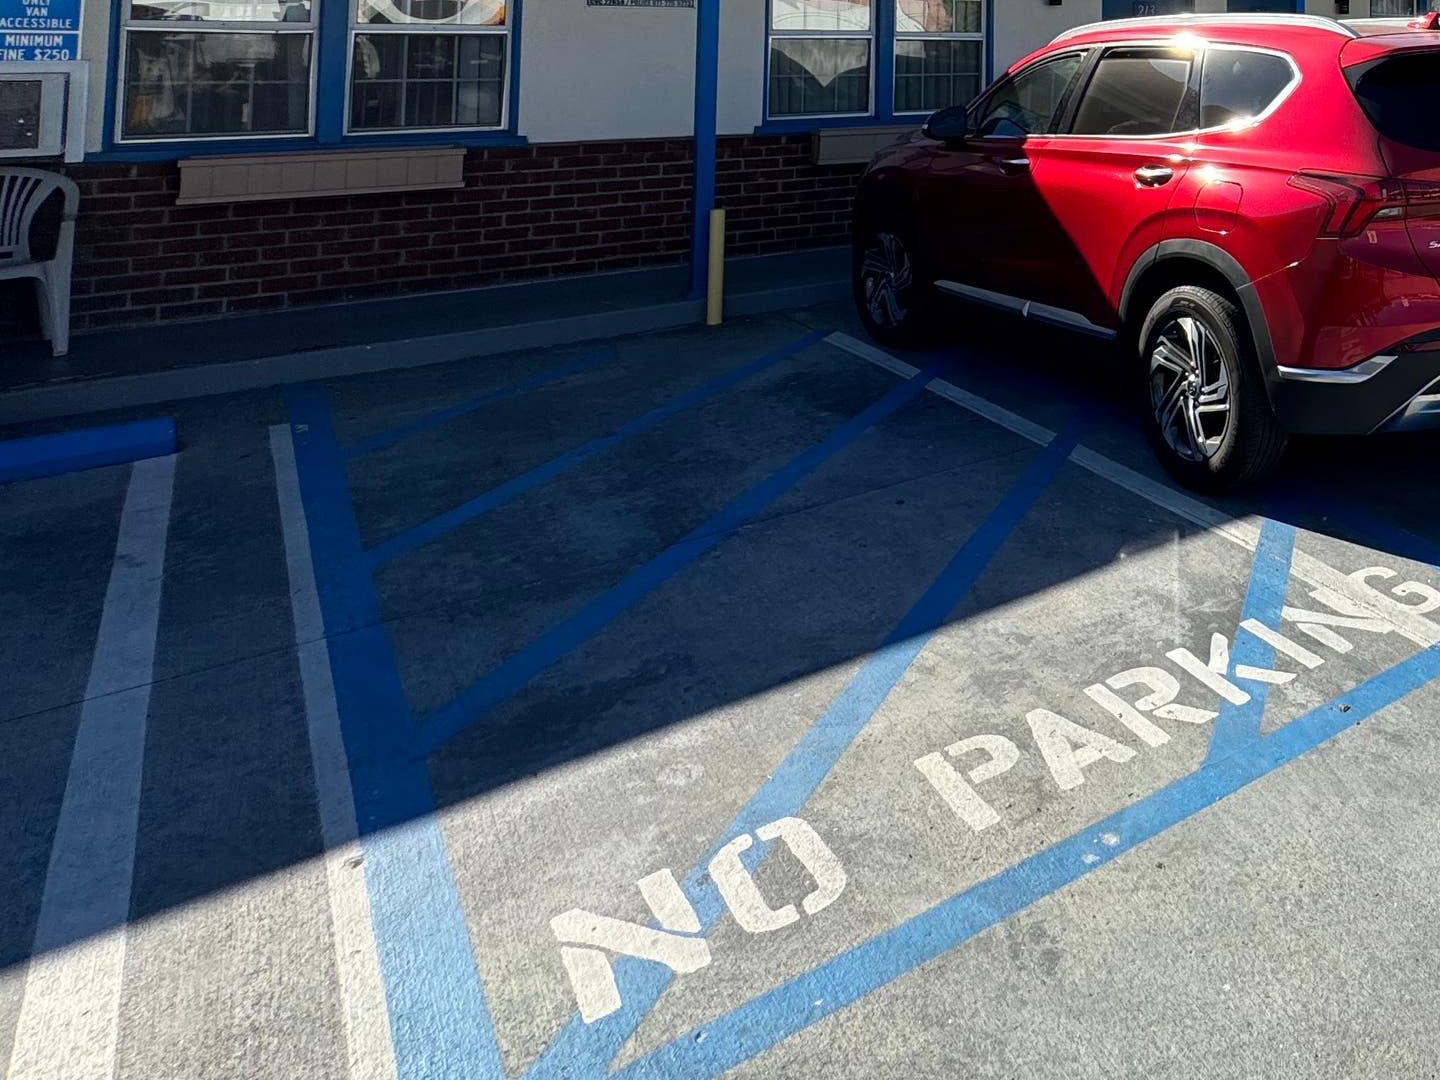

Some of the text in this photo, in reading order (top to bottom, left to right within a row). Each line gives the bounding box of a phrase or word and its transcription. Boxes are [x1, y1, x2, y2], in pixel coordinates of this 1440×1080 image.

[26, 6, 48, 17] VAN
[0, 17, 73, 29] ACCESSIBLE
[4, 34, 63, 47] MINIMUM
[34, 48, 70, 61] $250
[549, 816, 848, 1025] NO
